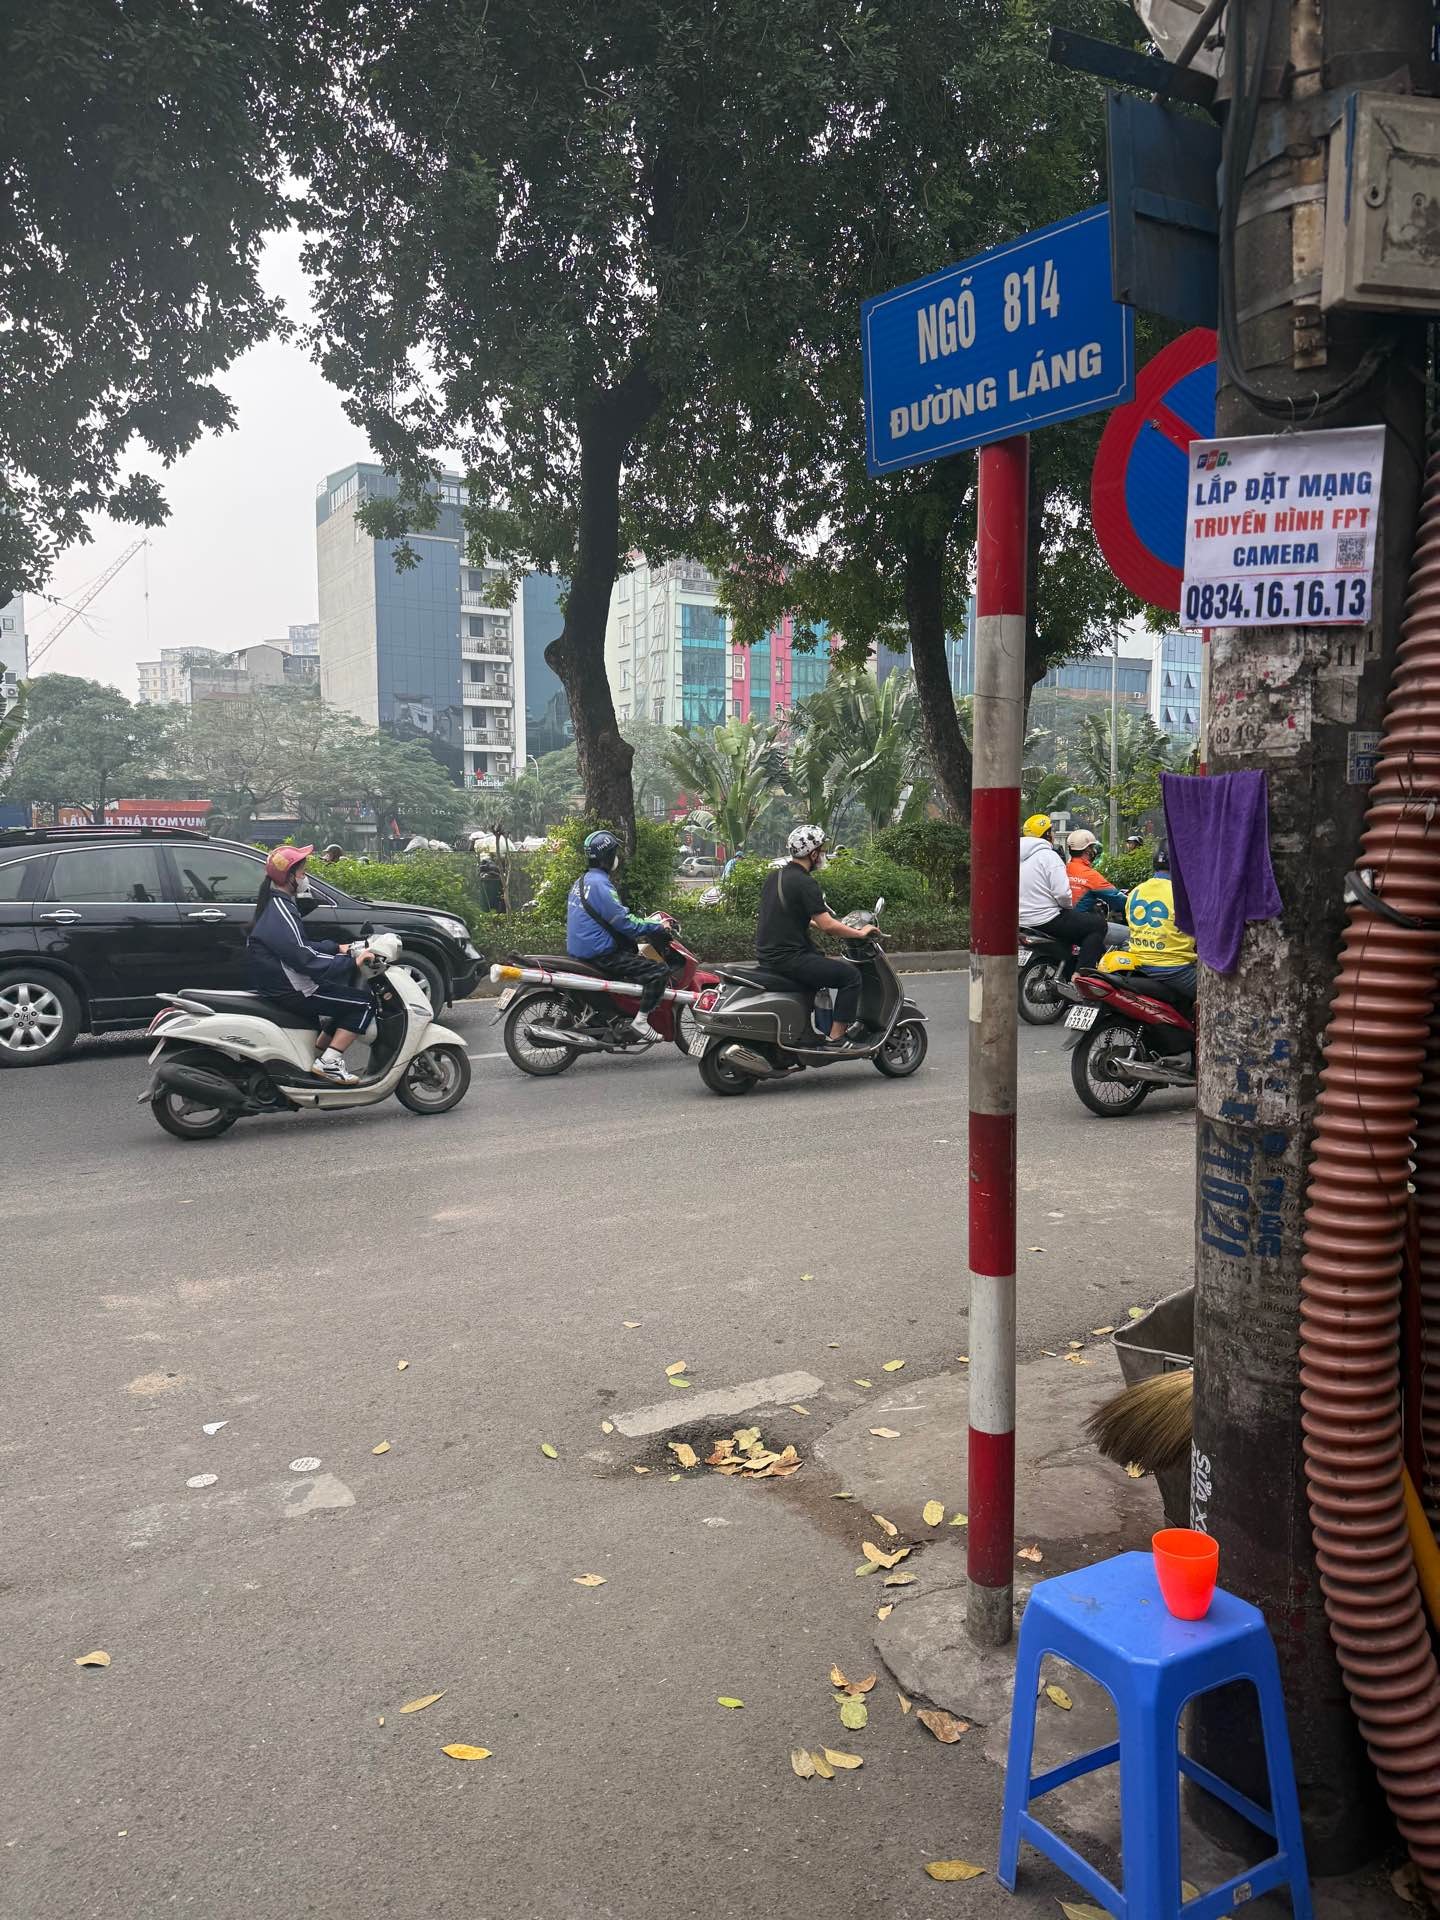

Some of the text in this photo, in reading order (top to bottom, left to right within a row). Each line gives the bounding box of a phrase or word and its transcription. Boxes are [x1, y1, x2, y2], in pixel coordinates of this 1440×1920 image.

[917, 259, 1060, 364] NGÕ 814
[890, 342, 1102, 440] ĐƯỜNG LÁNG
[1196, 471, 1372, 506] LẮP ĐẶT MẠNG
[1194, 507, 1370, 538] TRUYỀN HÌNH FPT
[1233, 543, 1319, 567] CAMERA
[1186, 579, 1366, 620] 0834.16.16.13
[117, 814, 147, 826] THÁI
[151, 816, 207, 826] TOMYUM
[1129, 889, 1169, 928] be
